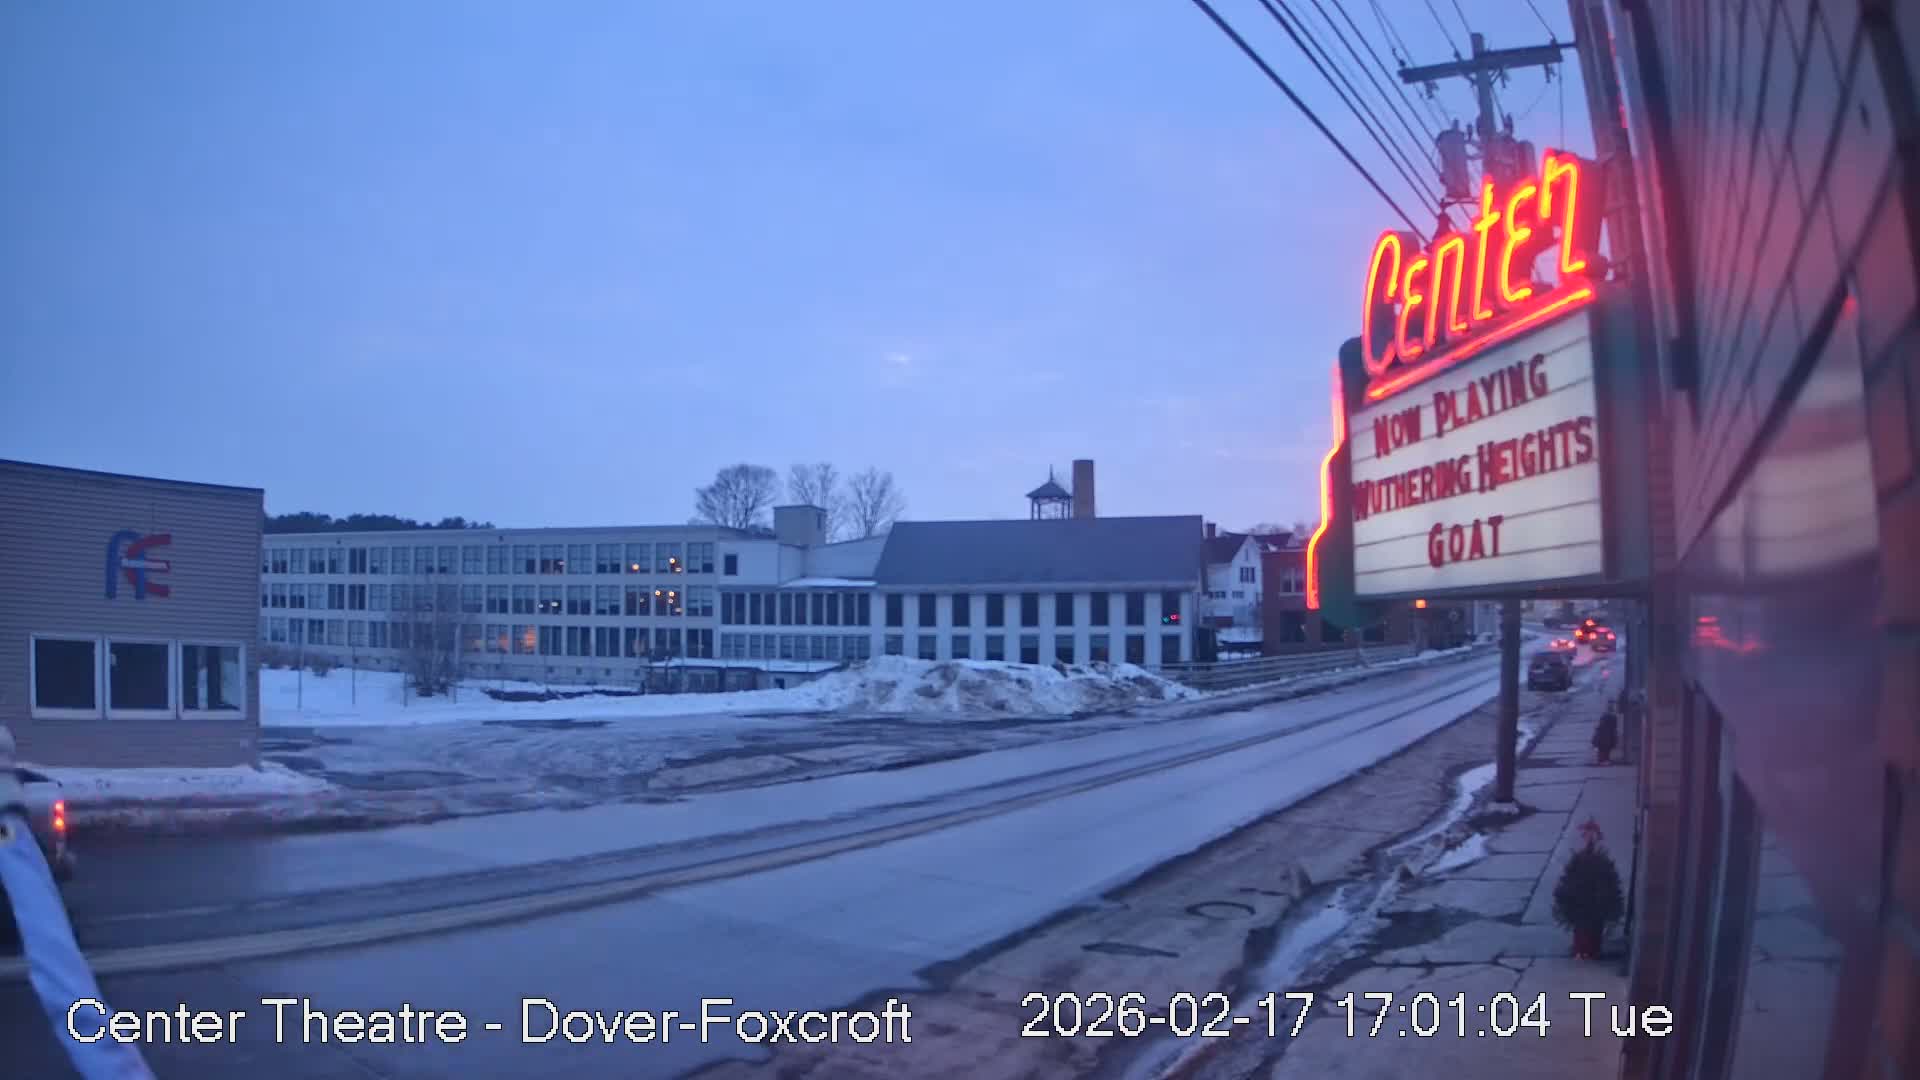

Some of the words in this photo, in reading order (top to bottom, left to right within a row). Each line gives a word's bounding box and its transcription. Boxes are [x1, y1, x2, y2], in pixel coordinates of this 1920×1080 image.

[1374, 405, 1421, 458] NOW
[1433, 353, 1548, 438] PLAYING
[1352, 455, 1471, 522] WUTHERING
[1477, 415, 1594, 494] HEIGHTS
[1428, 514, 1503, 568] GOAT
